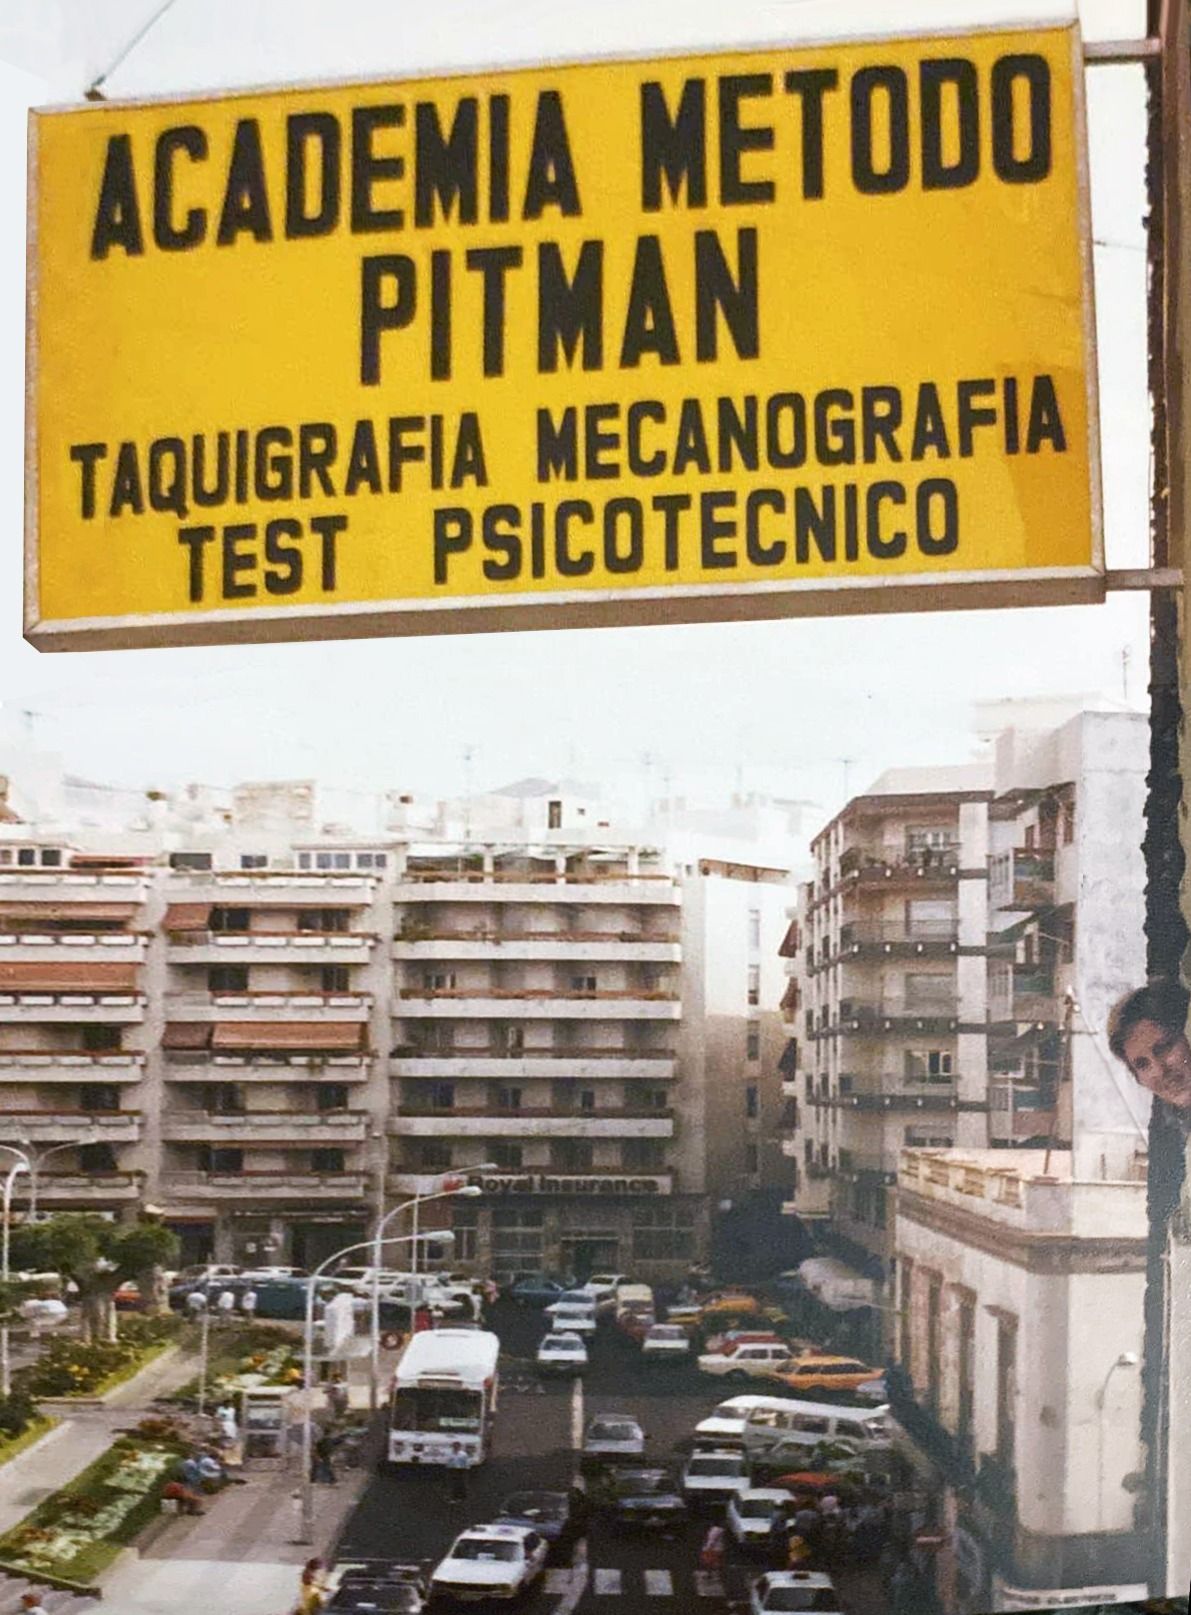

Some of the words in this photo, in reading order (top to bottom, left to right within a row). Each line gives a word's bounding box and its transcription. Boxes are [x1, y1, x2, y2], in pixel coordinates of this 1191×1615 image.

[91, 91, 581, 260] ACADEMIA
[641, 54, 1051, 211] METODO
[361, 228, 758, 385] PITMAN
[70, 413, 487, 519] TAQUIGRAFIA
[537, 375, 1066, 482] MECANOGRAFIA
[178, 515, 347, 602] TEST
[434, 478, 958, 584] PSICOTECNICO
[467, 1174, 533, 1193] Royal
[540, 1174, 659, 1192] Insurance
